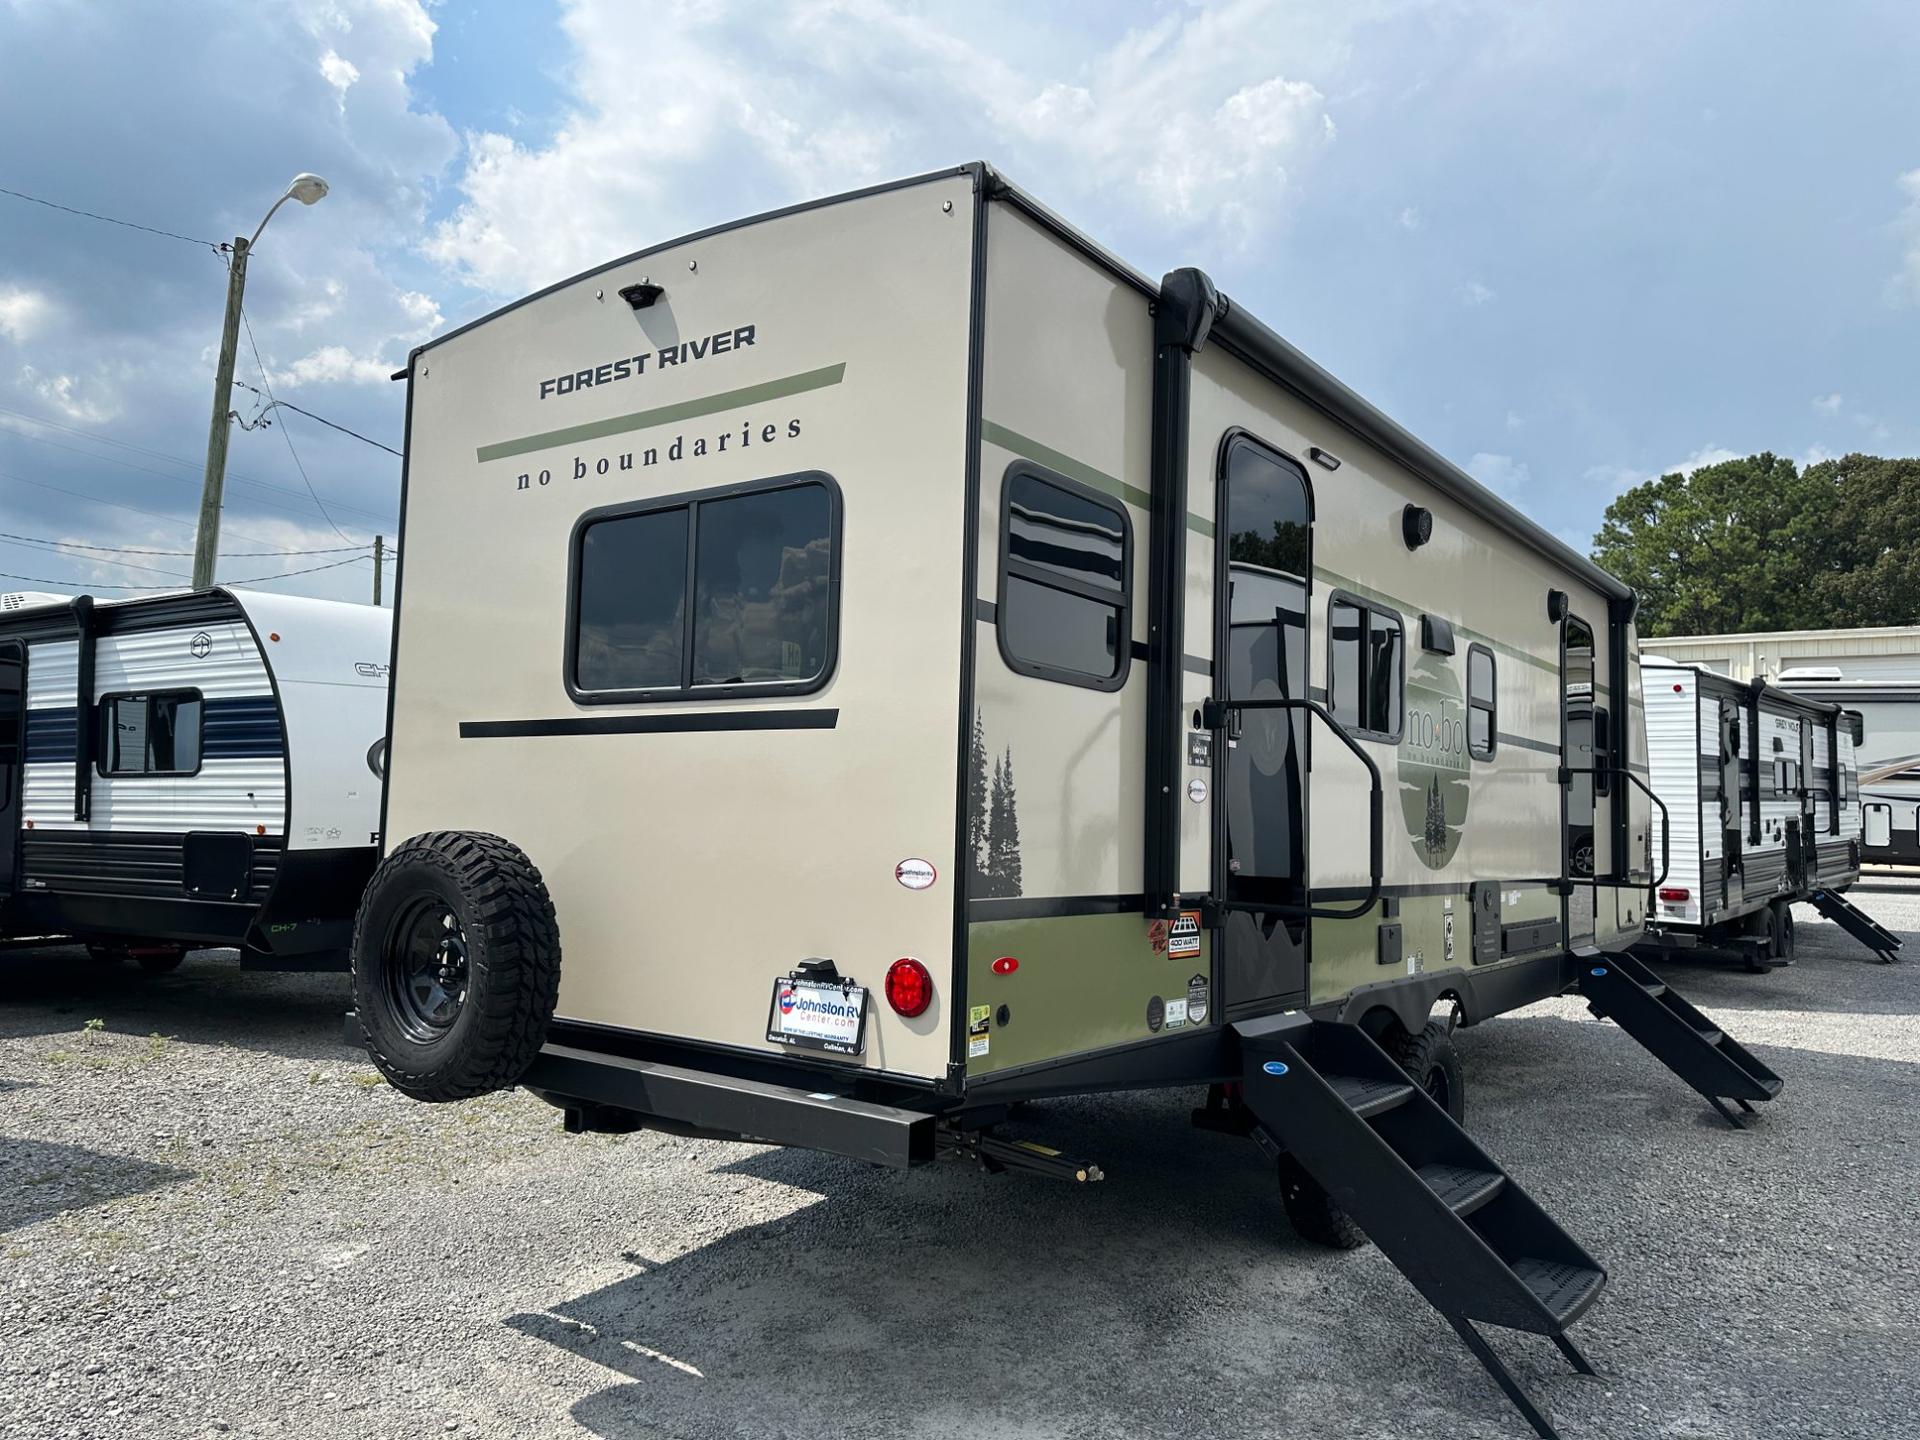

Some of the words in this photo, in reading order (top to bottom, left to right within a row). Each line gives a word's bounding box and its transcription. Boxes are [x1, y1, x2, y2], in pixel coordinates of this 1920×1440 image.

[540, 353, 651, 400] FOREST
[658, 324, 756, 369] RIVER
[517, 469, 551, 490] no
[573, 419, 801, 479] boundaries
[796, 998, 845, 1017] Johnston
[846, 1006, 861, 1019] RV
[800, 1011, 855, 1028] Center.com
